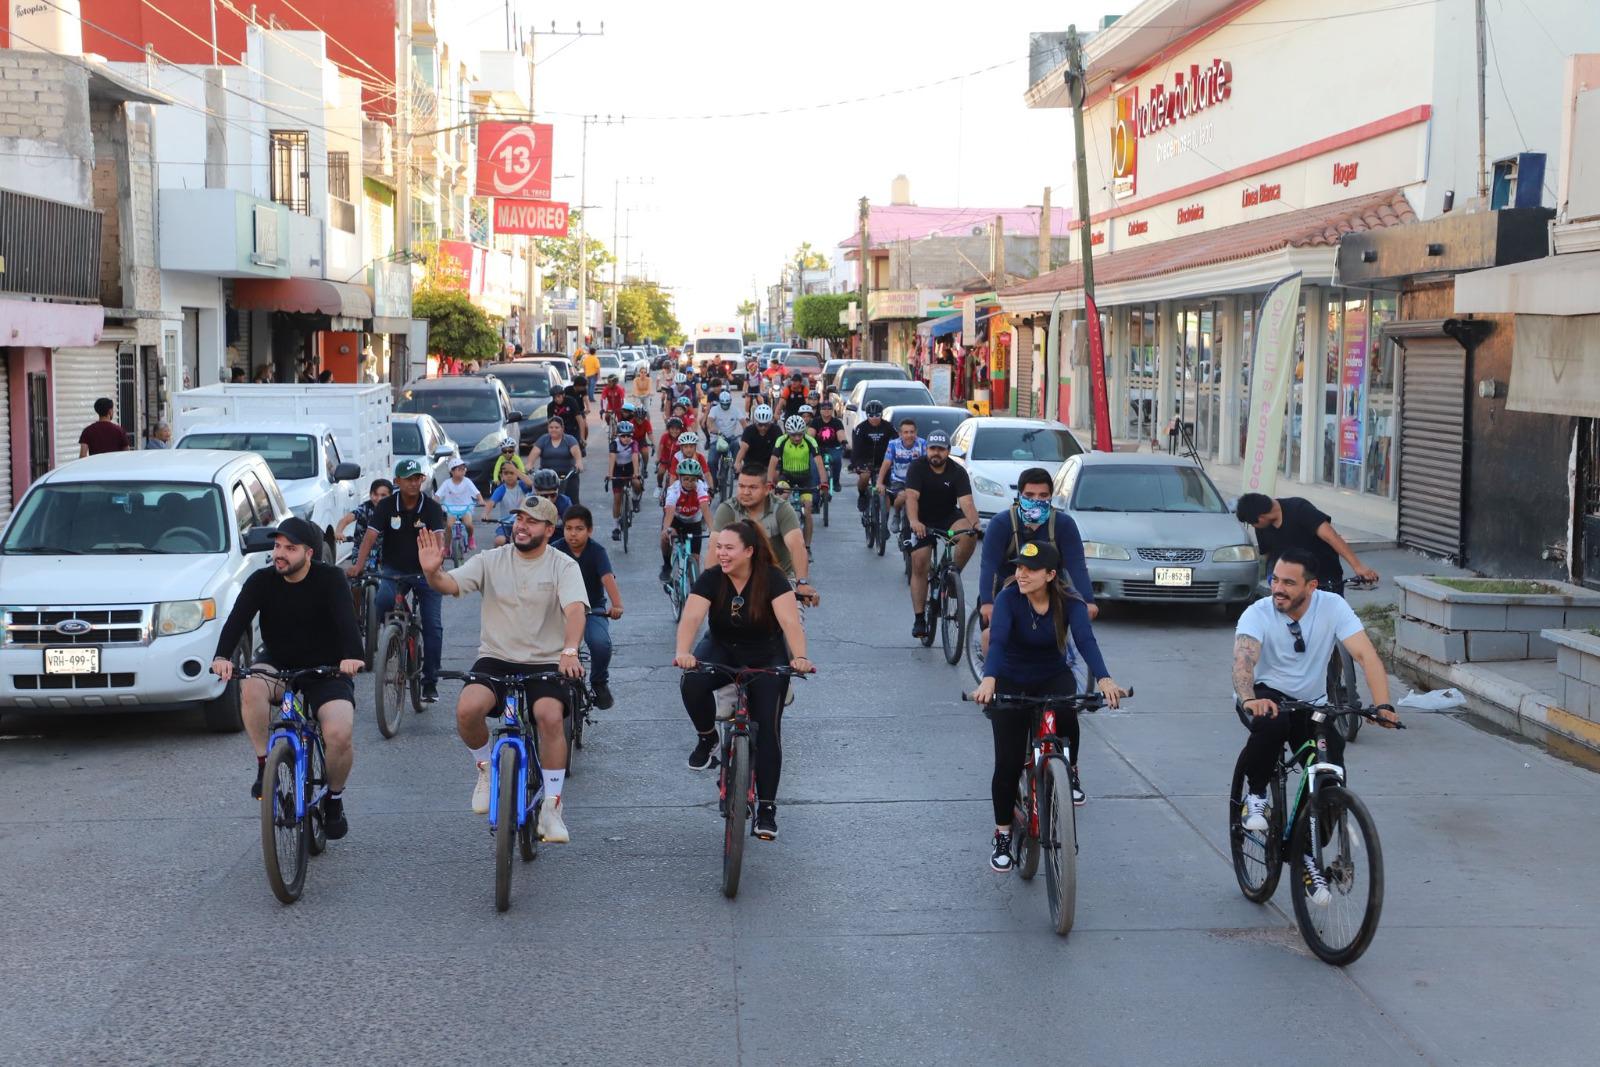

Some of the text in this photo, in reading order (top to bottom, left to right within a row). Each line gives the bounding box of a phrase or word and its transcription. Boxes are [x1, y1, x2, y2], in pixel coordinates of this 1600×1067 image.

[499, 146, 531, 174] 13
[1333, 162, 1359, 187] Hogar
[1259, 184, 1281, 203] Blanca
[498, 206, 565, 229] MAYOREO
[48, 655, 96, 667] VRH-499-C
